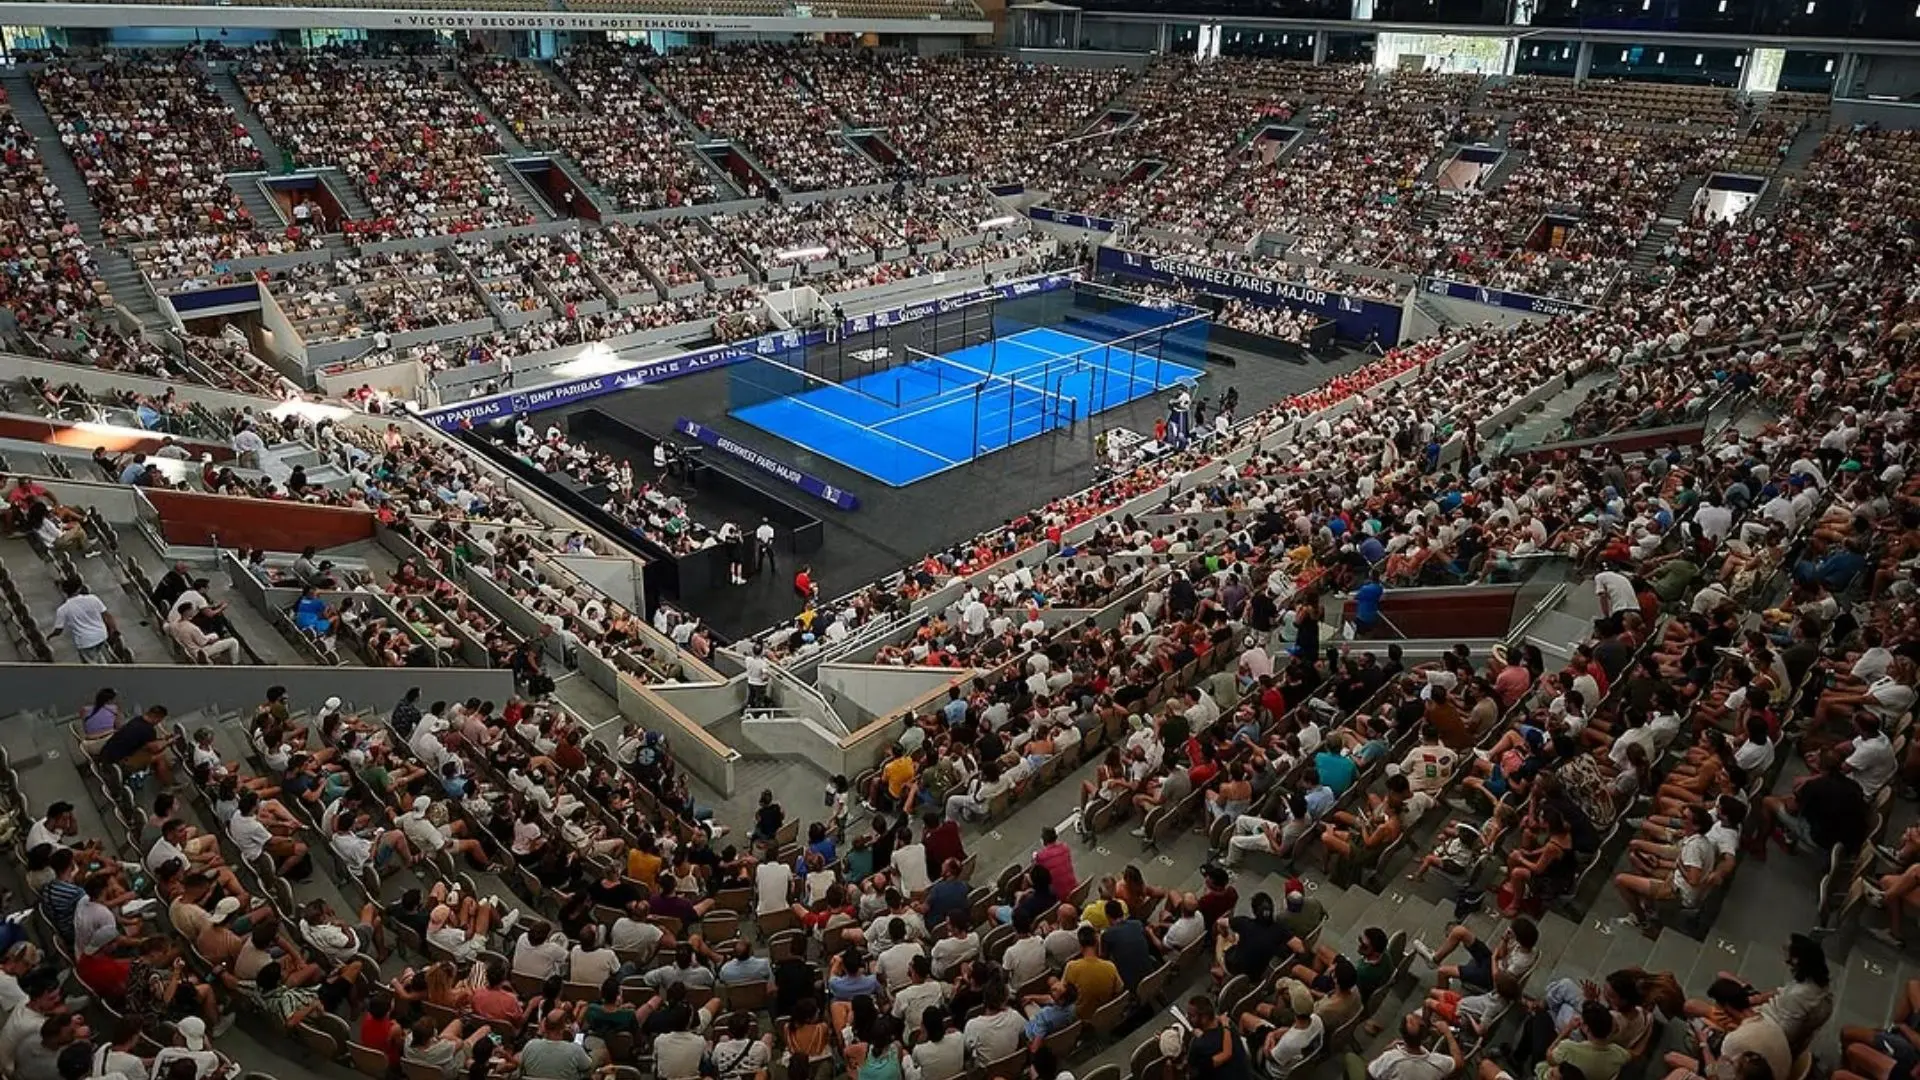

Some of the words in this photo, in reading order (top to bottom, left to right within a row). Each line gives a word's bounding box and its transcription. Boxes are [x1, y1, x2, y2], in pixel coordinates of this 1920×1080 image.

[408, 16, 474, 26] VICTORY
[481, 18, 543, 27] BELONGS
[550, 19, 565, 27] TO
[572, 19, 594, 27] THE
[600, 20, 631, 28] MOST
[637, 20, 702, 29] TENACIOUS
[1151, 258, 1230, 286] GREENWEEZ
[1233, 274, 1272, 295] PARIS
[1276, 283, 1327, 306] MAJOR
[614, 362, 680, 386] ALPINE
[530, 390, 554, 405] BNP
[556, 379, 603, 399] PARIBAS
[447, 402, 500, 423] PARIBAS
[756, 455, 777, 473] PARIS
[777, 464, 802, 485] MAJOR
